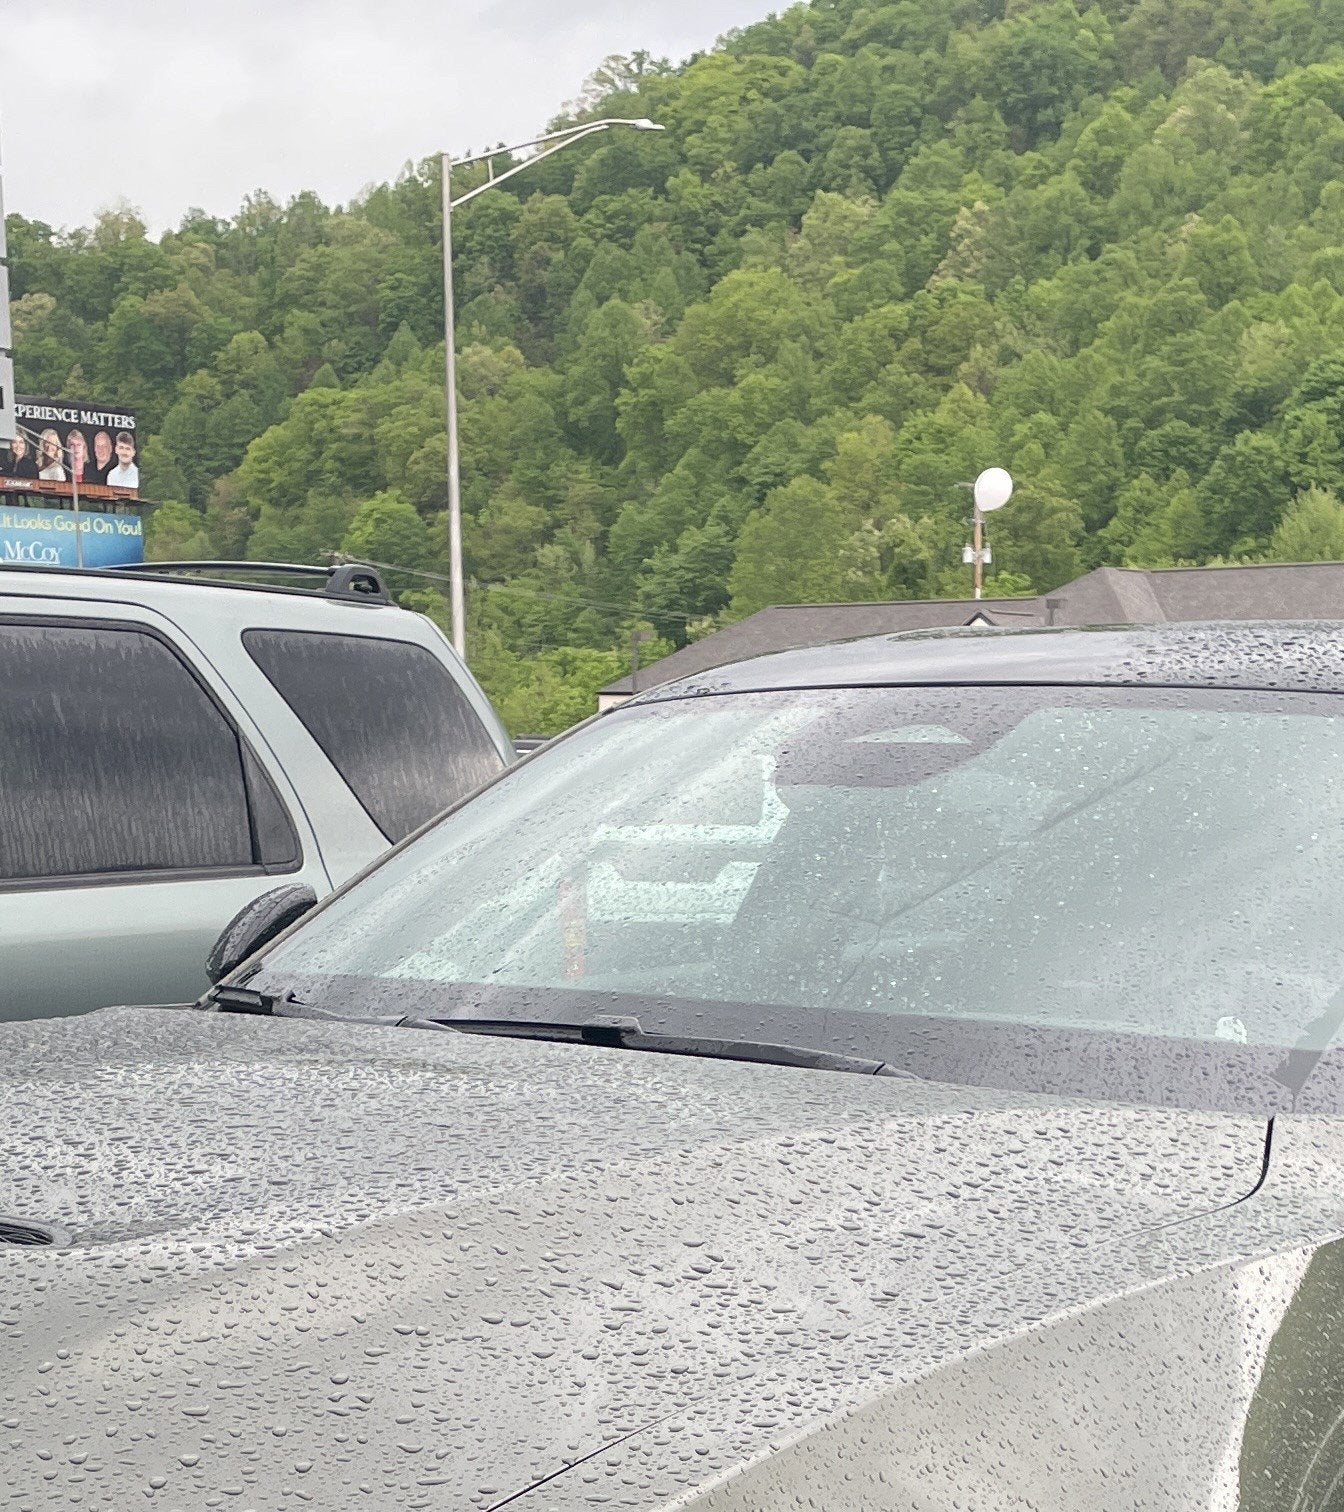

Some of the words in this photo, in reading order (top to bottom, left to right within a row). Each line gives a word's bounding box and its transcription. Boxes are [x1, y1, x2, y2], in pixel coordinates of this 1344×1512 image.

[14, 403, 79, 423] PERIENCE
[80, 410, 136, 429] MATTERS
[14, 514, 52, 530] Looks
[93, 518, 113, 534] On
[115, 519, 142, 535] You!
[3, 540, 62, 565] McCoy
